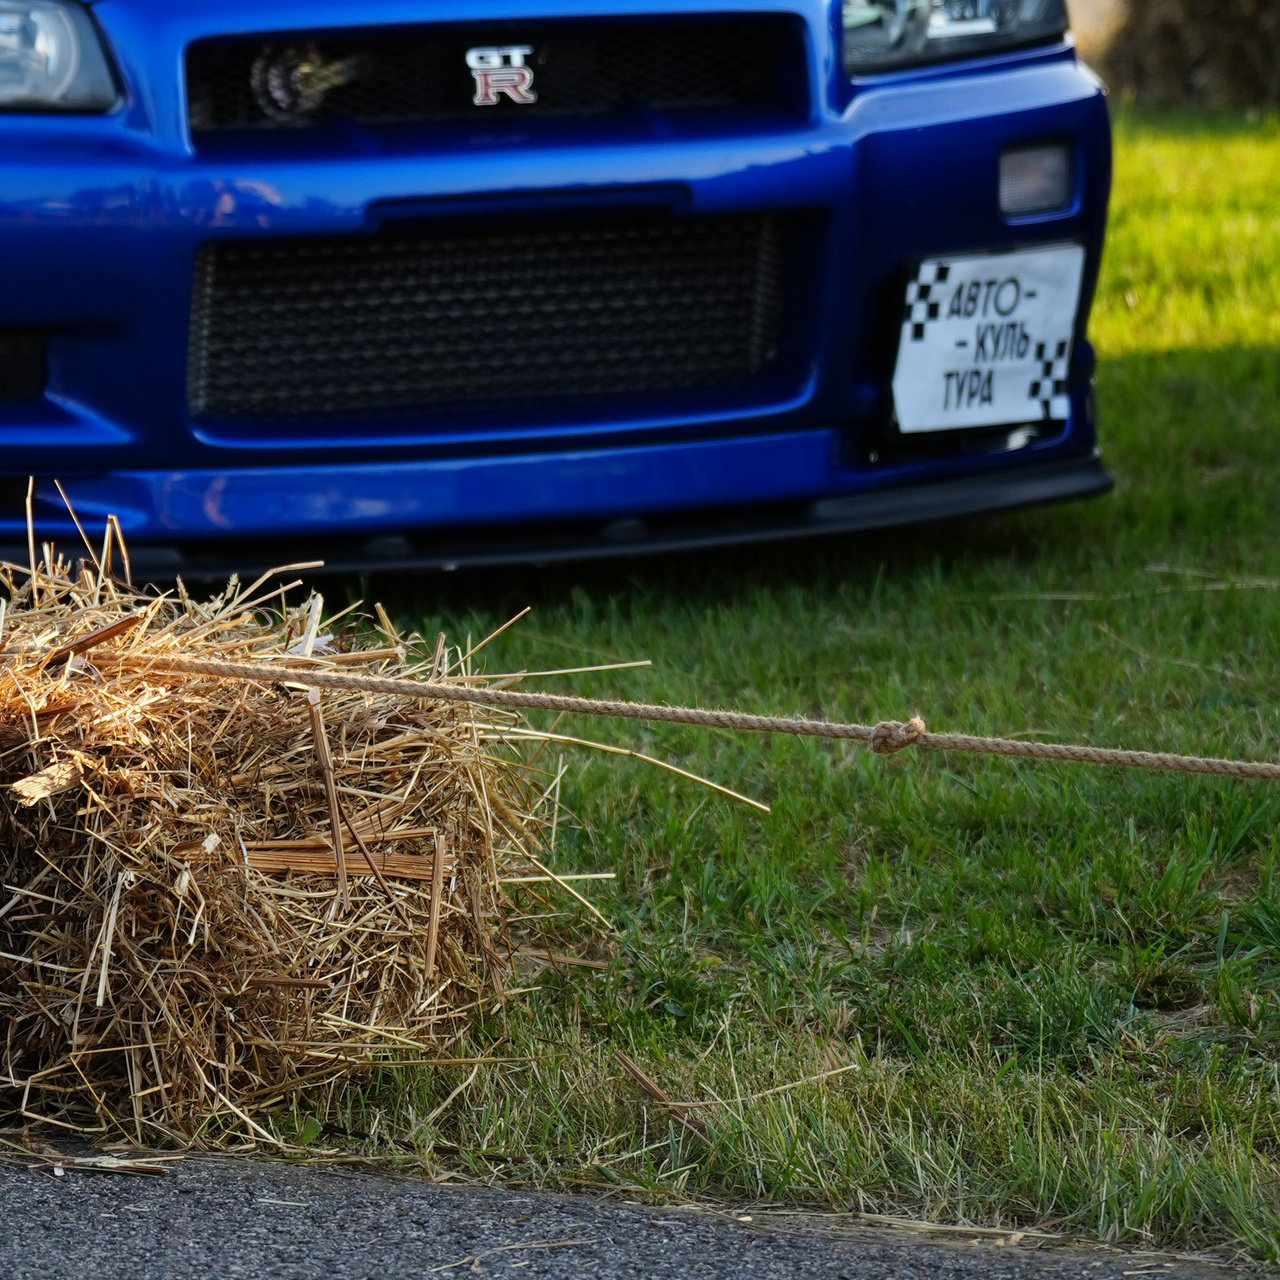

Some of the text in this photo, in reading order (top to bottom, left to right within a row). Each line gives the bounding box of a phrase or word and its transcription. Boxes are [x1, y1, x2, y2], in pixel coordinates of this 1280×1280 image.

[465, 45, 534, 69] GT
[471, 67, 538, 106] R
[947, 276, 1037, 320] АВТО-
[943, 369, 994, 411] ТУРА
